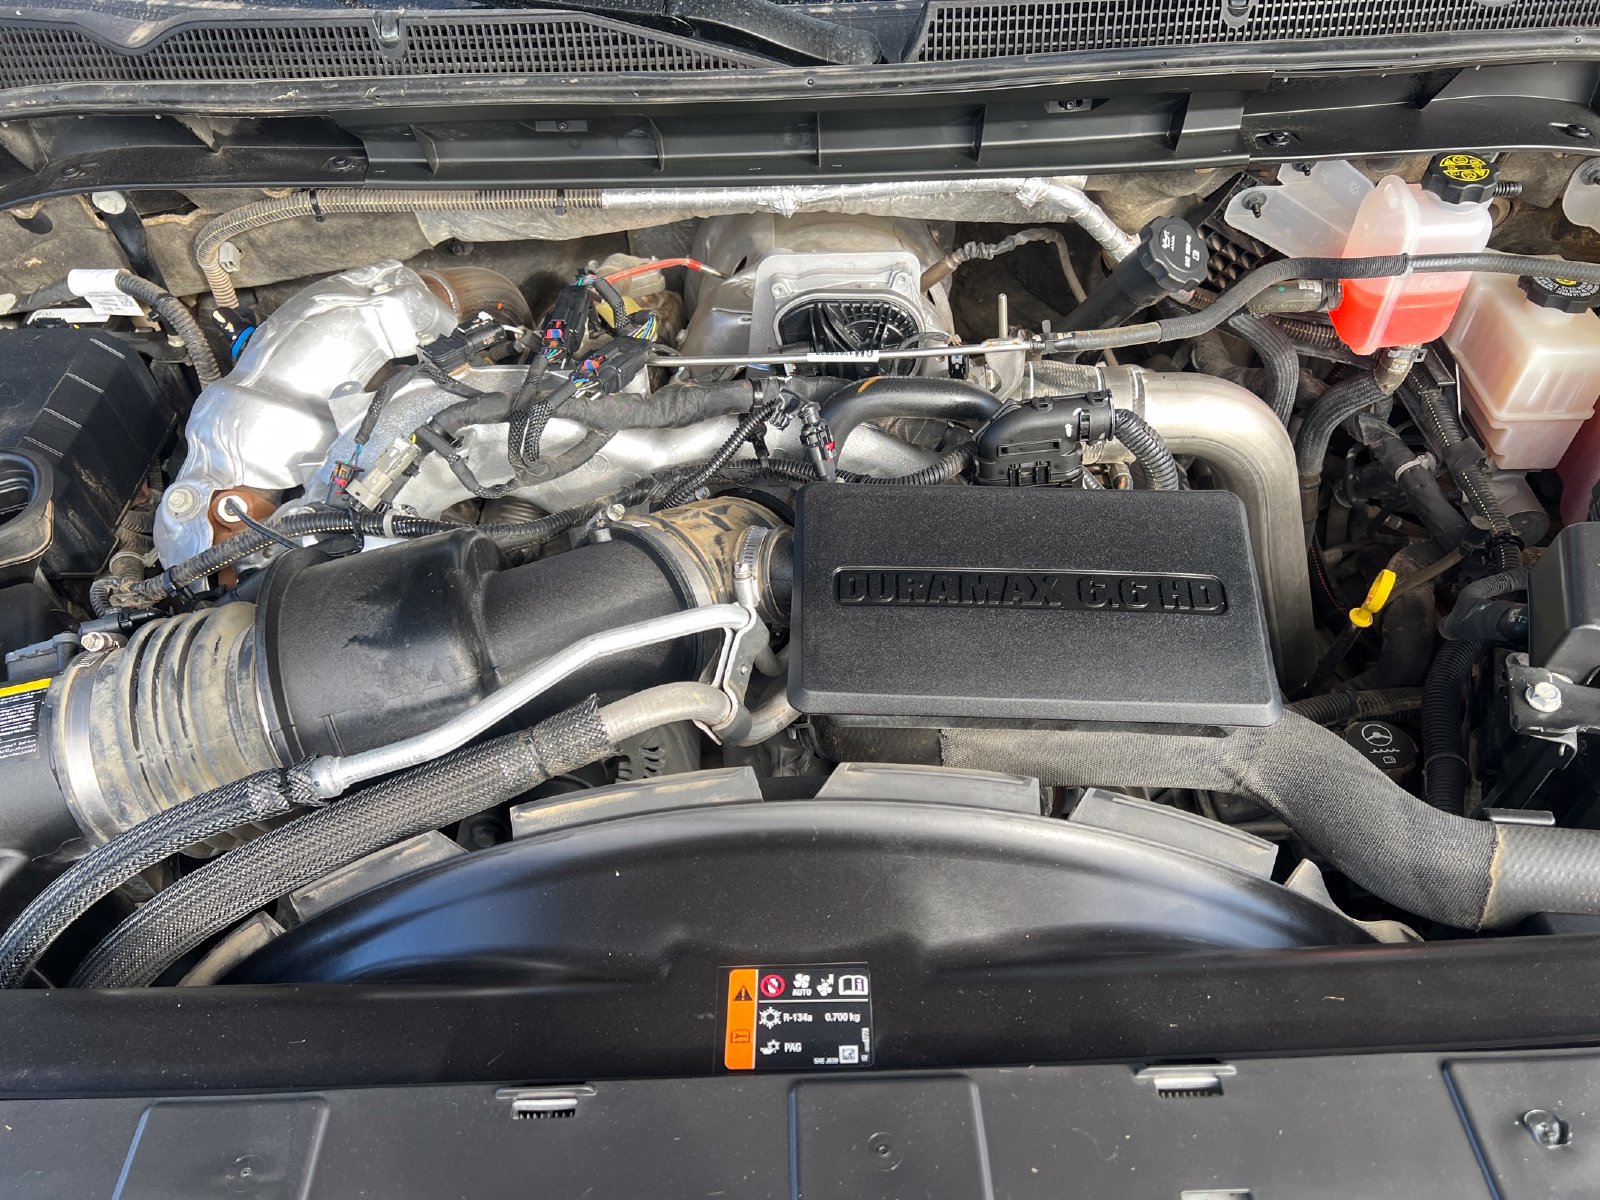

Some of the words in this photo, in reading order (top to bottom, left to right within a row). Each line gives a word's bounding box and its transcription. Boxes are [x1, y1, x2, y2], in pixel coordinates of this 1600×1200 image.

[838, 573, 1063, 608] DURAMAX
[1077, 576, 1149, 608] 6.6
[1157, 579, 1221, 610] HD
[792, 988, 812, 996] AUTO
[783, 1012, 813, 1022] R-134a
[824, 1012, 848, 1022] 0.700
[849, 1012, 861, 1023] kg
[784, 1042, 802, 1053] PAG
